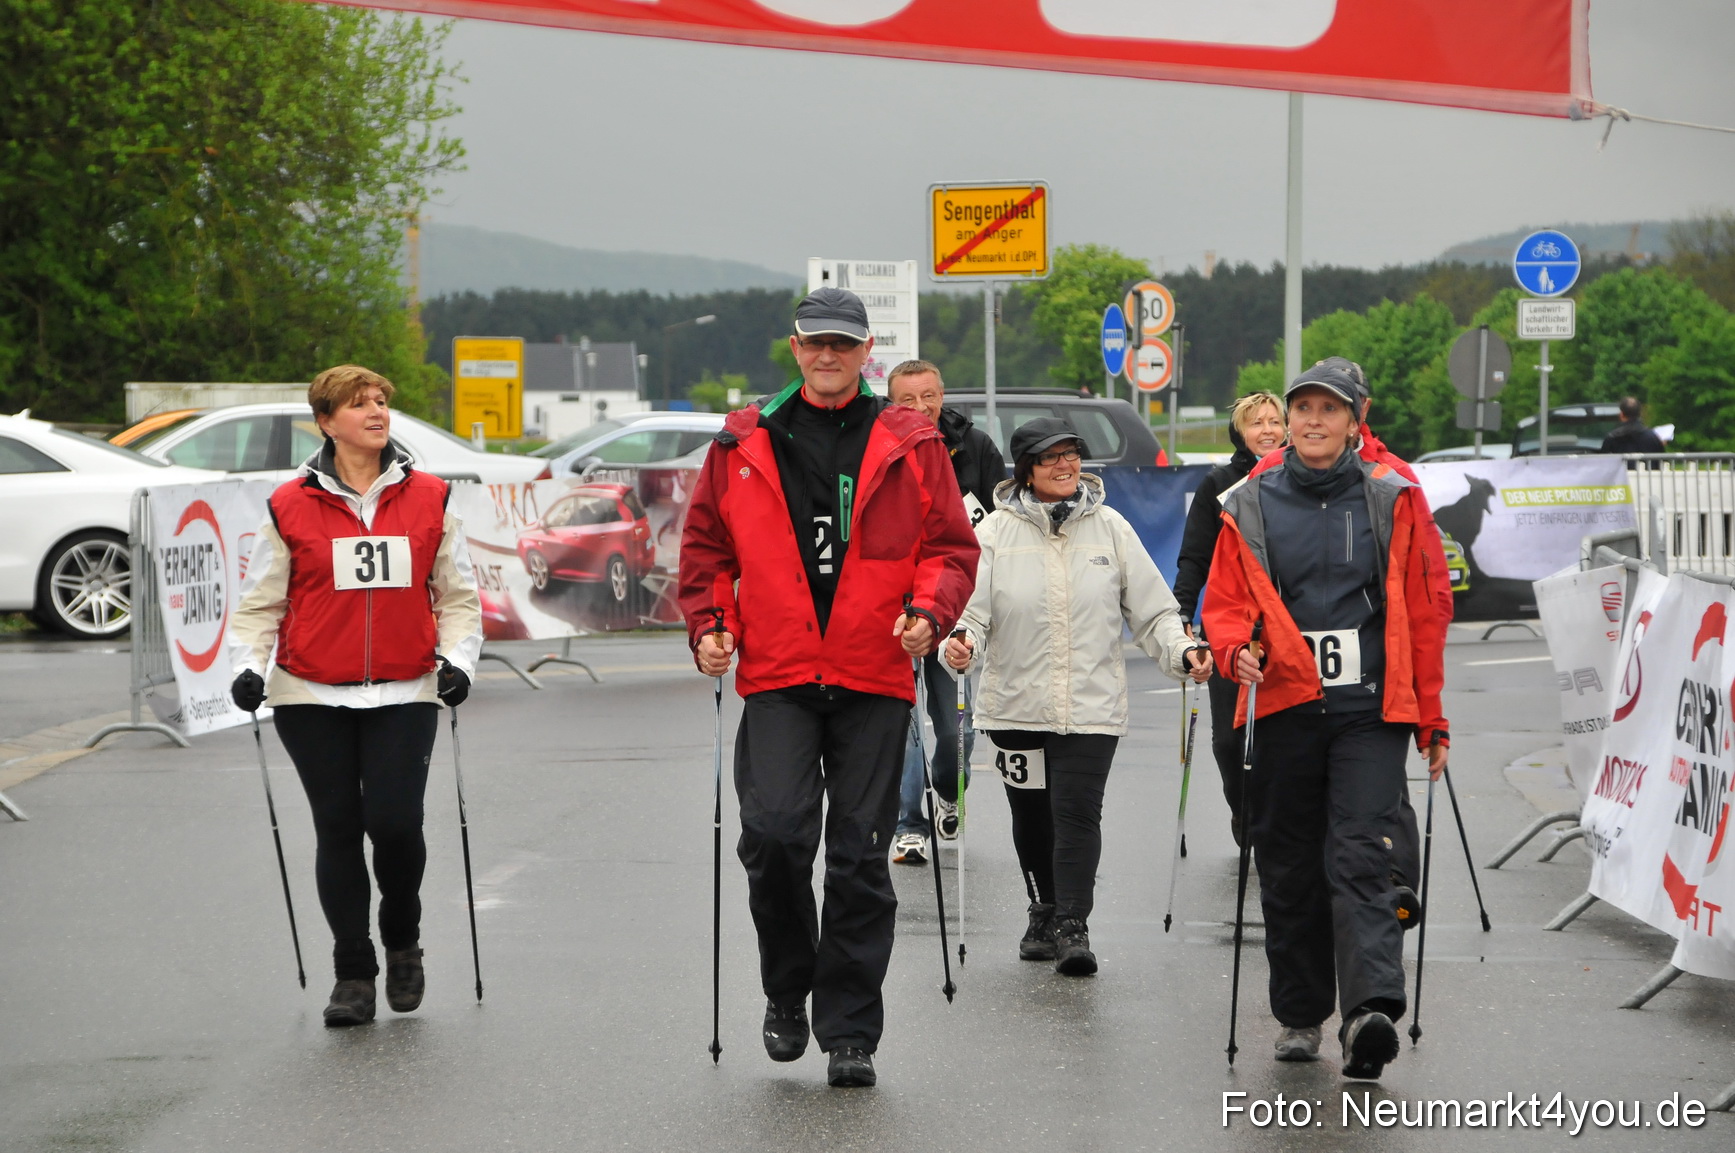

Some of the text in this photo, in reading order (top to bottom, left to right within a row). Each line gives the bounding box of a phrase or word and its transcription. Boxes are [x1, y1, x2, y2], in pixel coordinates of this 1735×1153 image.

[944, 199, 1035, 225] Sengenthal
[956, 229, 1023, 242] am Anger
[966, 252, 1006, 263] Neumarkt
[1526, 325, 1553, 334] Verkehr
[1505, 491, 1528, 504] DER
[1529, 490, 1554, 503] NEUE
[1556, 489, 1592, 503] PICANTO
[1595, 488, 1608, 502] IST
[1515, 512, 1538, 526] JETZT
[1540, 511, 1582, 525] EINFANGEN
[1584, 511, 1599, 524] UND
[160, 543, 213, 586] ERHART
[355, 541, 390, 583] 31
[183, 582, 221, 625] JÄNIG
[996, 750, 1029, 785] 43
